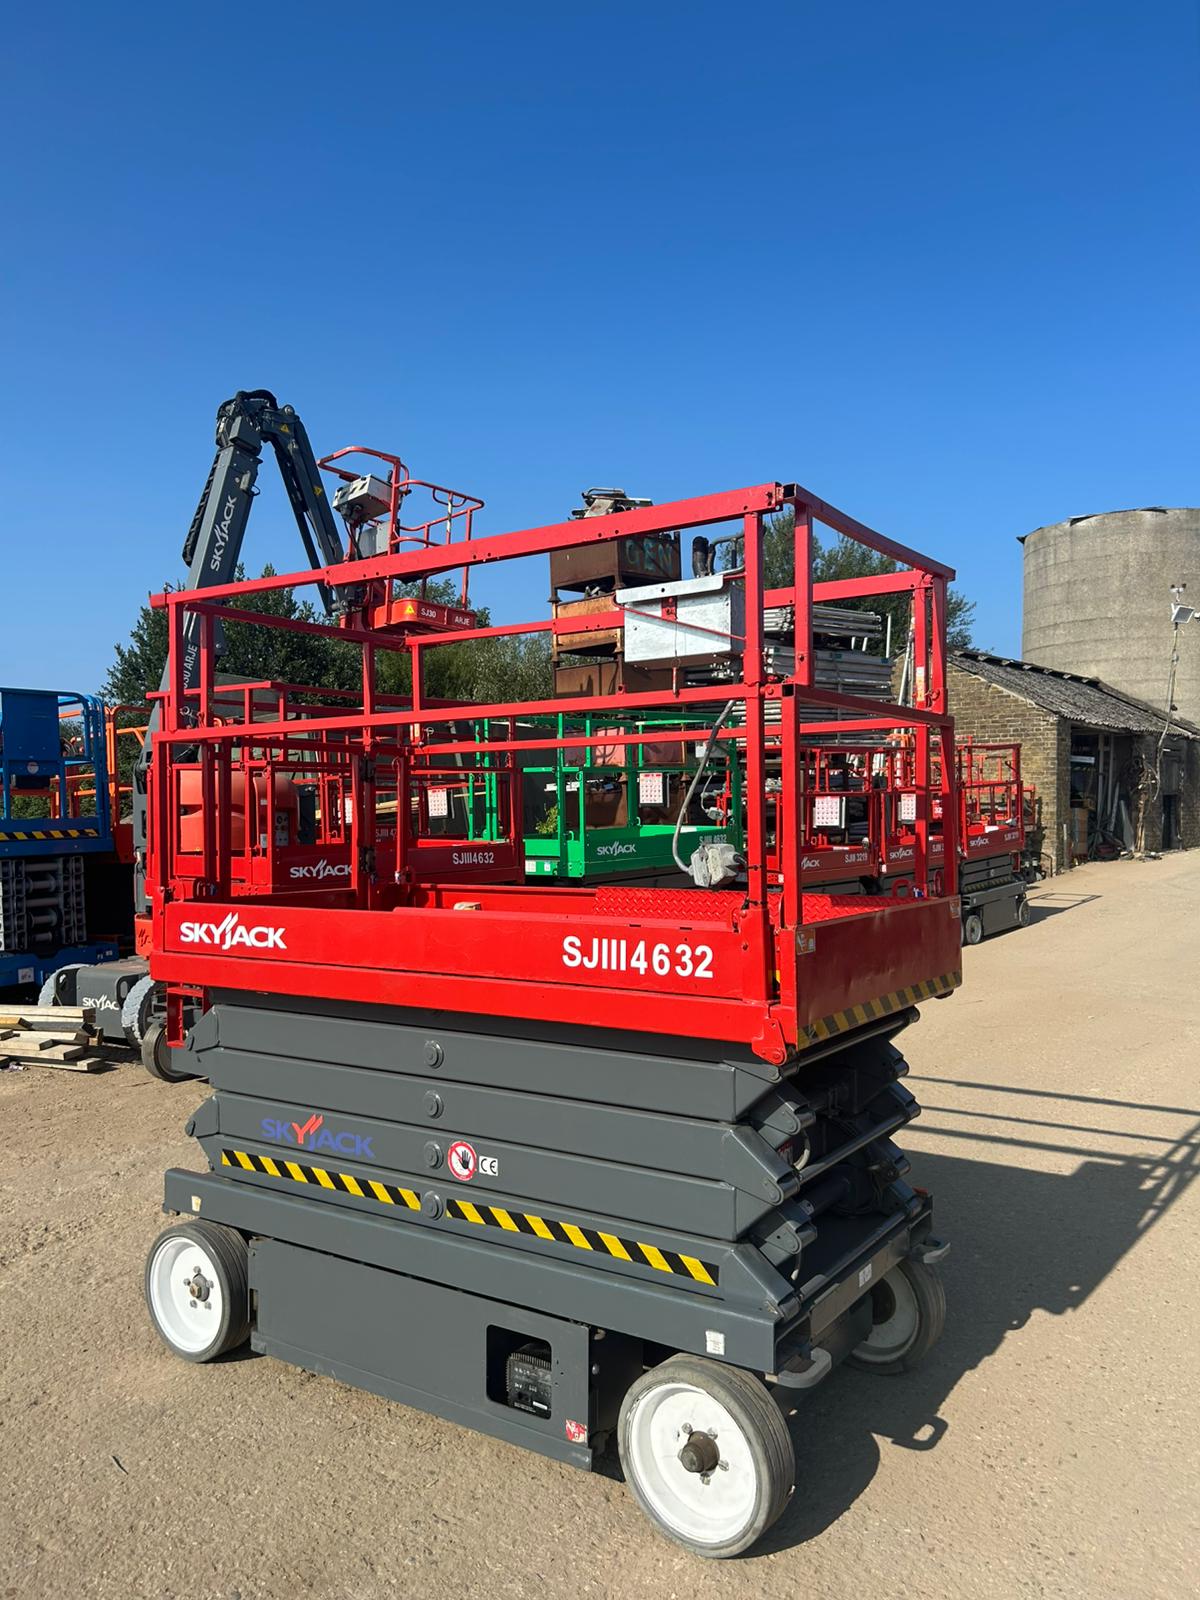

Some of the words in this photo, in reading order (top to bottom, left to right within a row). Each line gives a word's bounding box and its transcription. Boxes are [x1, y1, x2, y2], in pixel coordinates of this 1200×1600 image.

[210, 496, 237, 572] SKYJACK
[596, 841, 636, 856] SKYJACK
[889, 847, 913, 860] SKYJACK
[289, 859, 352, 880] SKYJACK
[180, 911, 287, 950] SKYJACK
[82, 994, 119, 1011] SKYJAC
[260, 1114, 375, 1159] SKYJACK
[480, 1158, 497, 1175] CE
